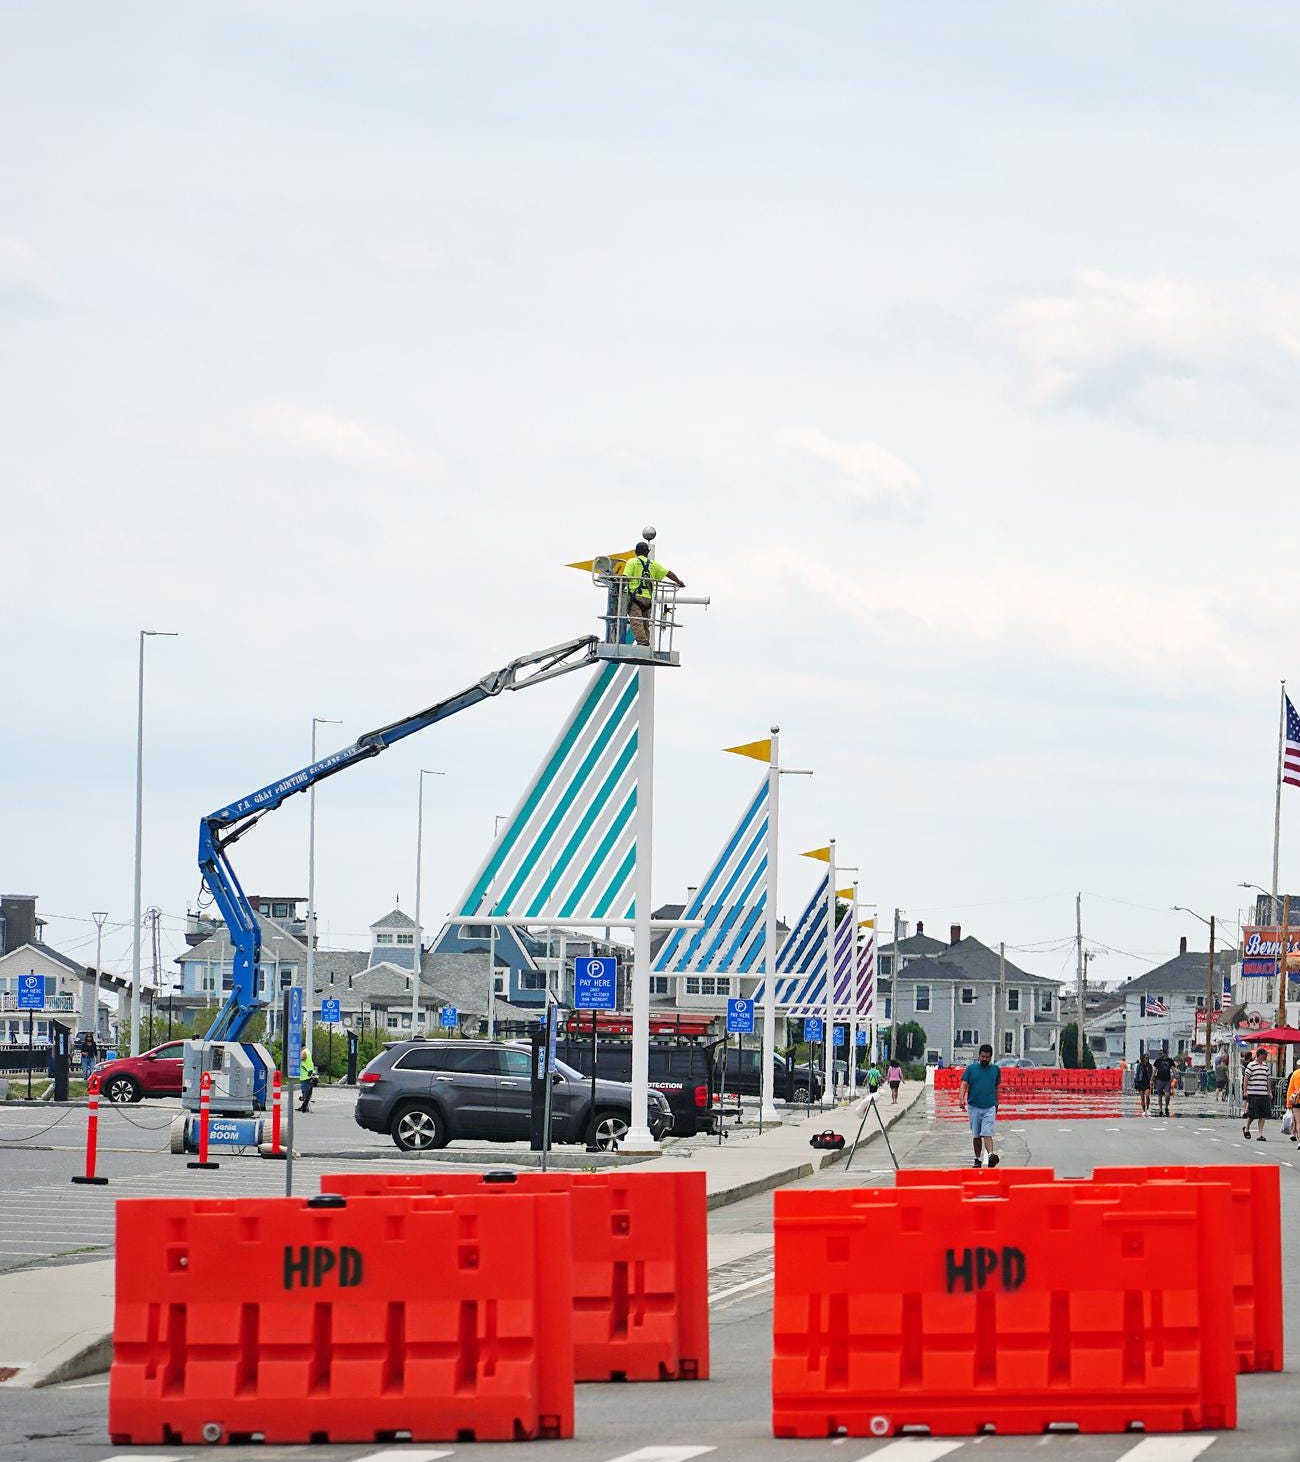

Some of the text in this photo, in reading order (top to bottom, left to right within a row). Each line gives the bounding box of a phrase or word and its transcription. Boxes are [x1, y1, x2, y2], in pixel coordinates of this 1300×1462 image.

[275, 772, 308, 794] PAINTING
[579, 979, 611, 987] PAY HERE
[647, 1082, 683, 1090] OTECTION
[213, 1122, 237, 1131] Genie
[209, 1131, 240, 1140] BOOM
[284, 1246, 363, 1290] HPD
[946, 1246, 1026, 1295] HPD
